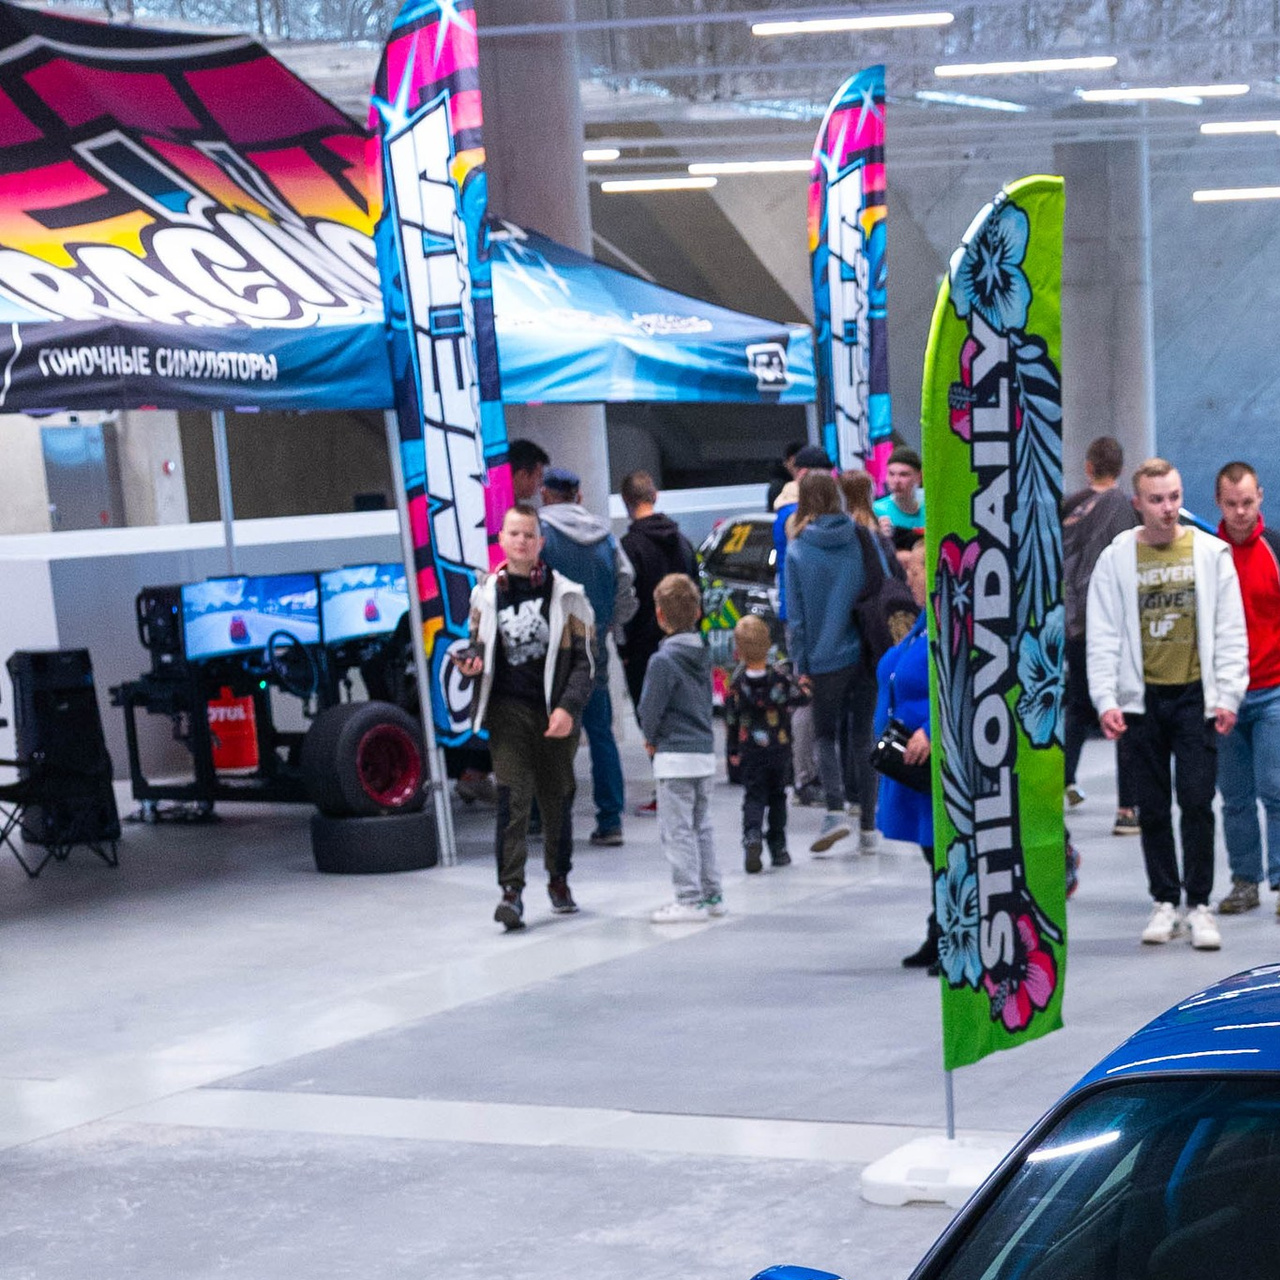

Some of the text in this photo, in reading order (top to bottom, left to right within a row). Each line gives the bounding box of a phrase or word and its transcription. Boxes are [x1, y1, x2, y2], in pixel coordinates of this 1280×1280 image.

[38, 345, 277, 381] ГОНОЧНЫЕ СИМУЛЯТОРЫ
[972, 310, 1015, 970] STILOVDAILY
[1149, 613, 1180, 637] UP
